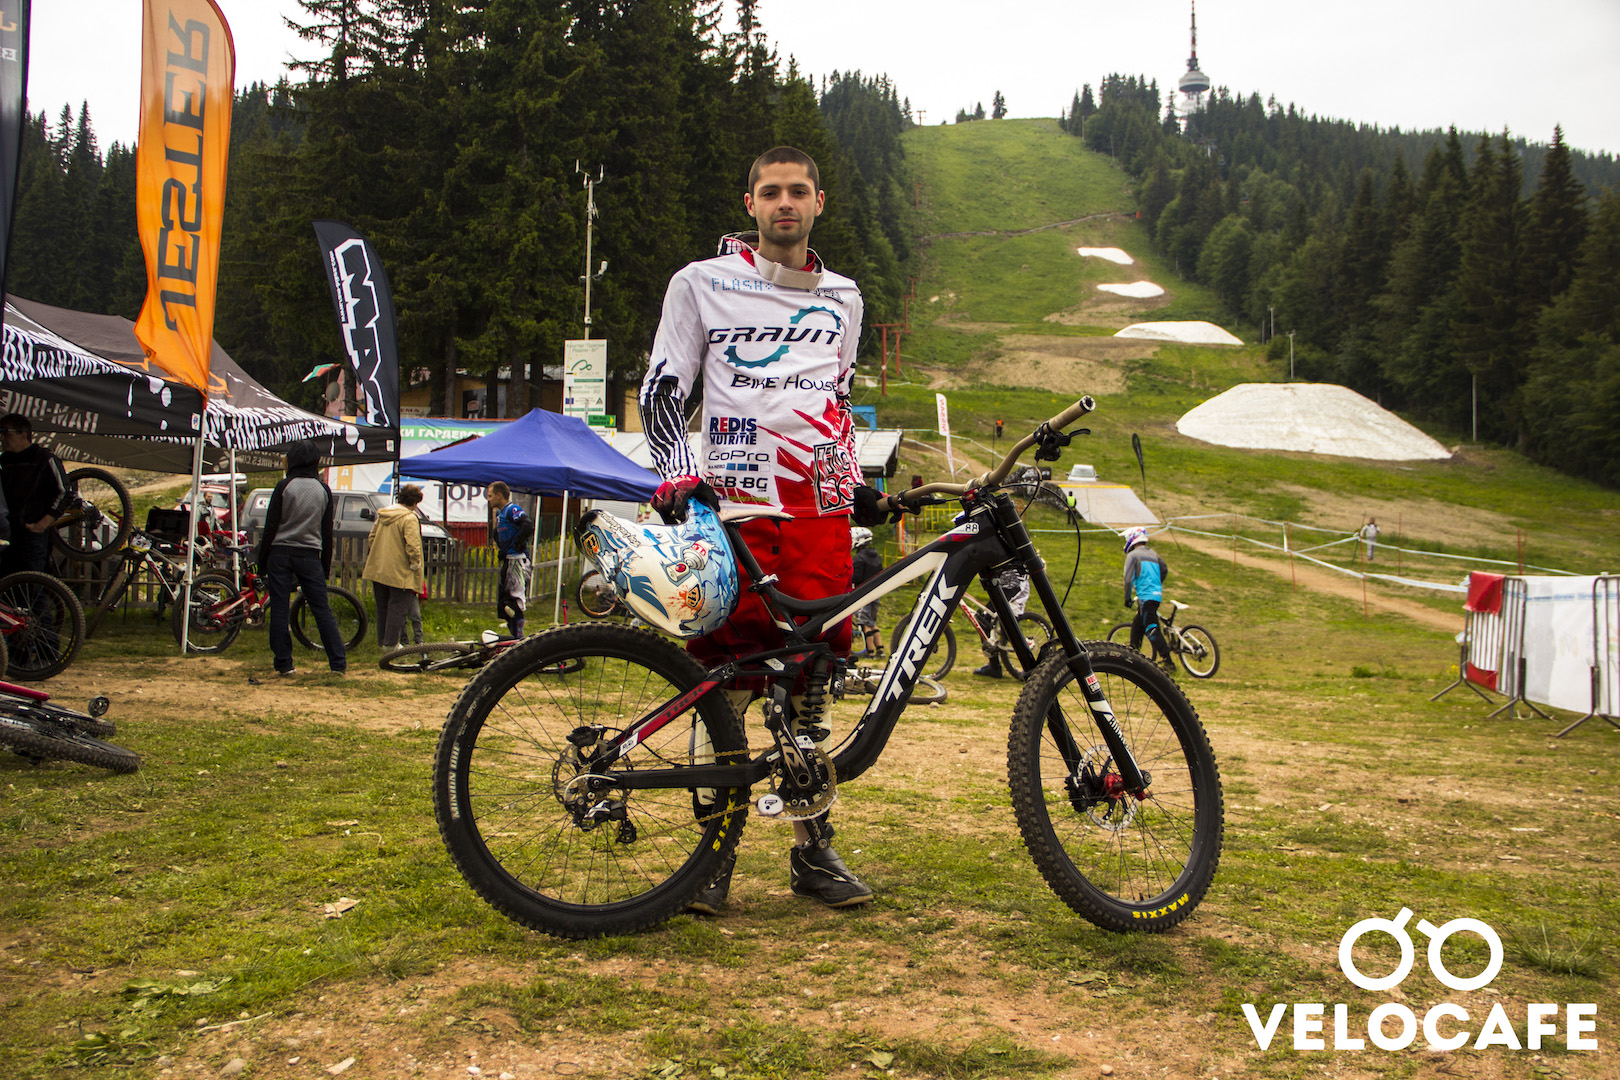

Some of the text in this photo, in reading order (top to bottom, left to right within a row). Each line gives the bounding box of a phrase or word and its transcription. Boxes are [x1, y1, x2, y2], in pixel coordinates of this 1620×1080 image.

[730, 373, 779, 389] BIKE
[709, 416, 757, 433] REDIS
[709, 433, 757, 445] NUTRITIE
[708, 450, 769, 462] GoPro
[965, 523, 978, 533] 88
[886, 573, 959, 701] TREK
[662, 685, 706, 718] TREK
[1132, 893, 1189, 919] MAXXIS
